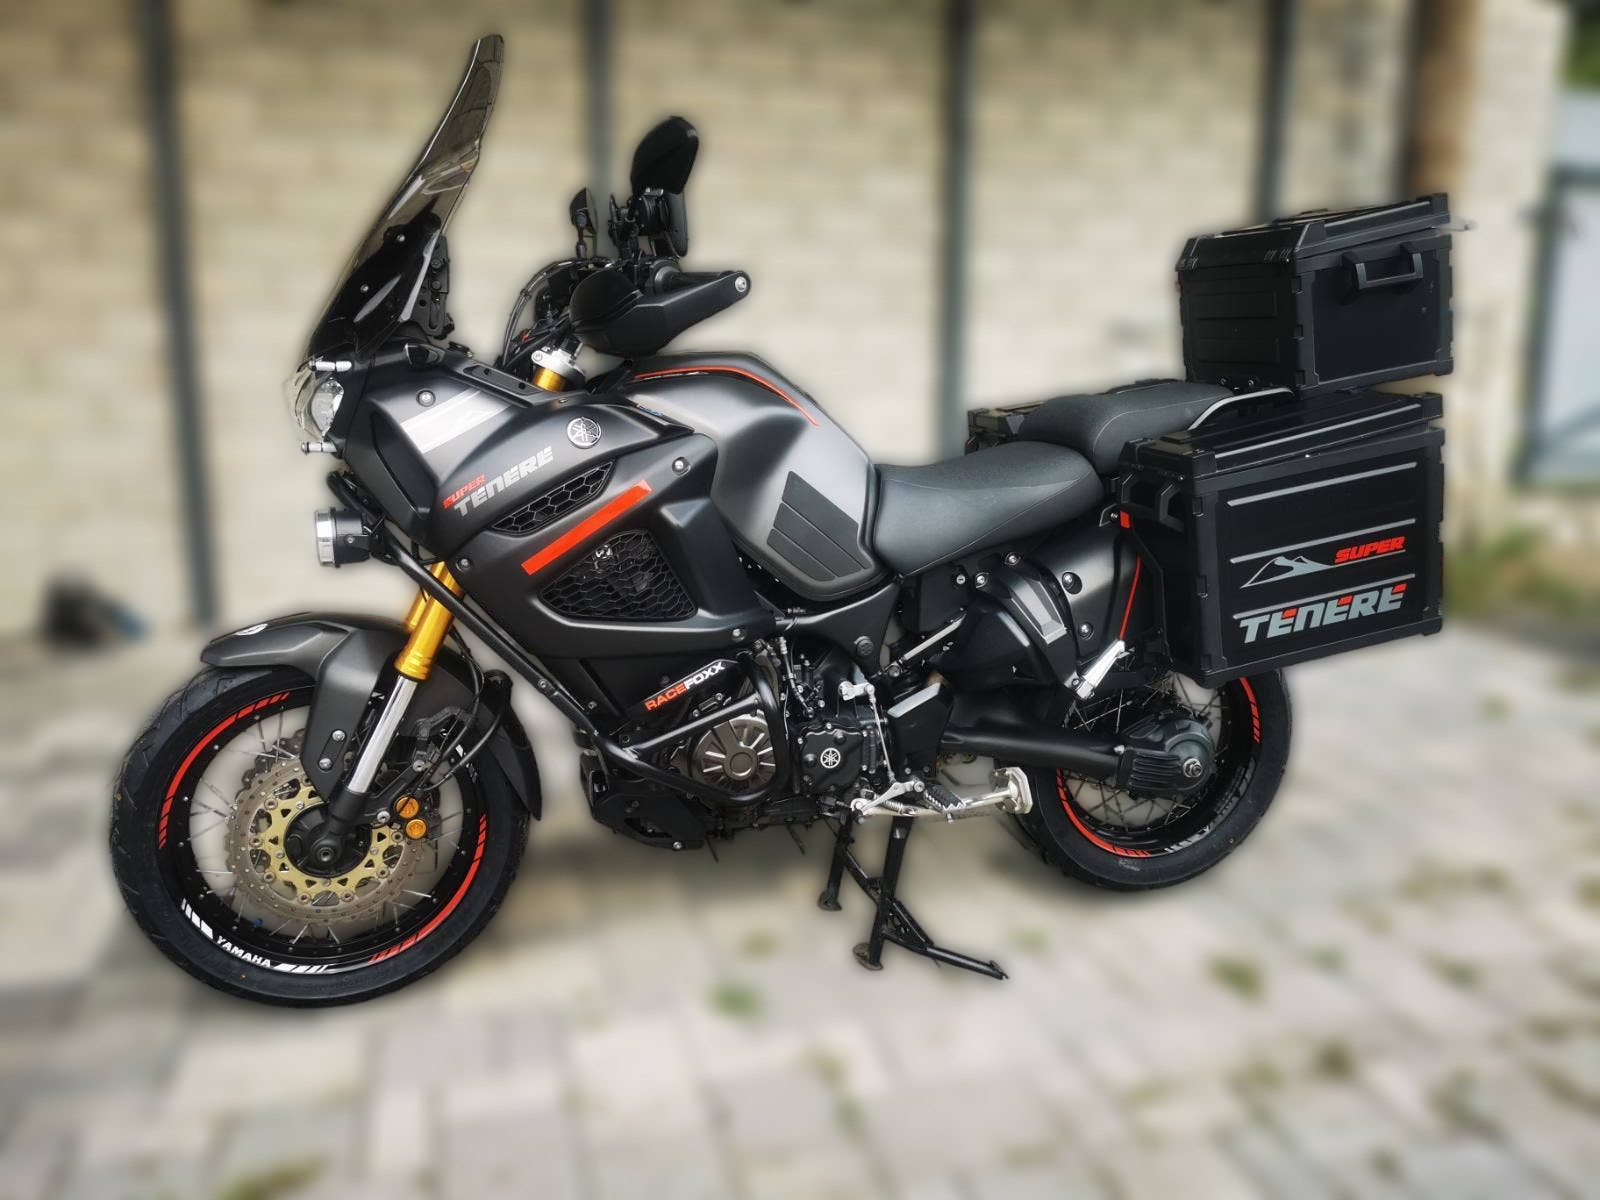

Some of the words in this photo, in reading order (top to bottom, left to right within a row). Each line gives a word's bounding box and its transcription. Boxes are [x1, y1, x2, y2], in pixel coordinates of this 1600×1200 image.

[442, 474, 487, 509] SUPER
[453, 446, 553, 517] TENERE
[1334, 536, 1406, 564] SUPER
[1239, 584, 1408, 644] TENERE
[644, 661, 725, 711] RACEFOXX
[216, 935, 271, 968] YAMAHA
